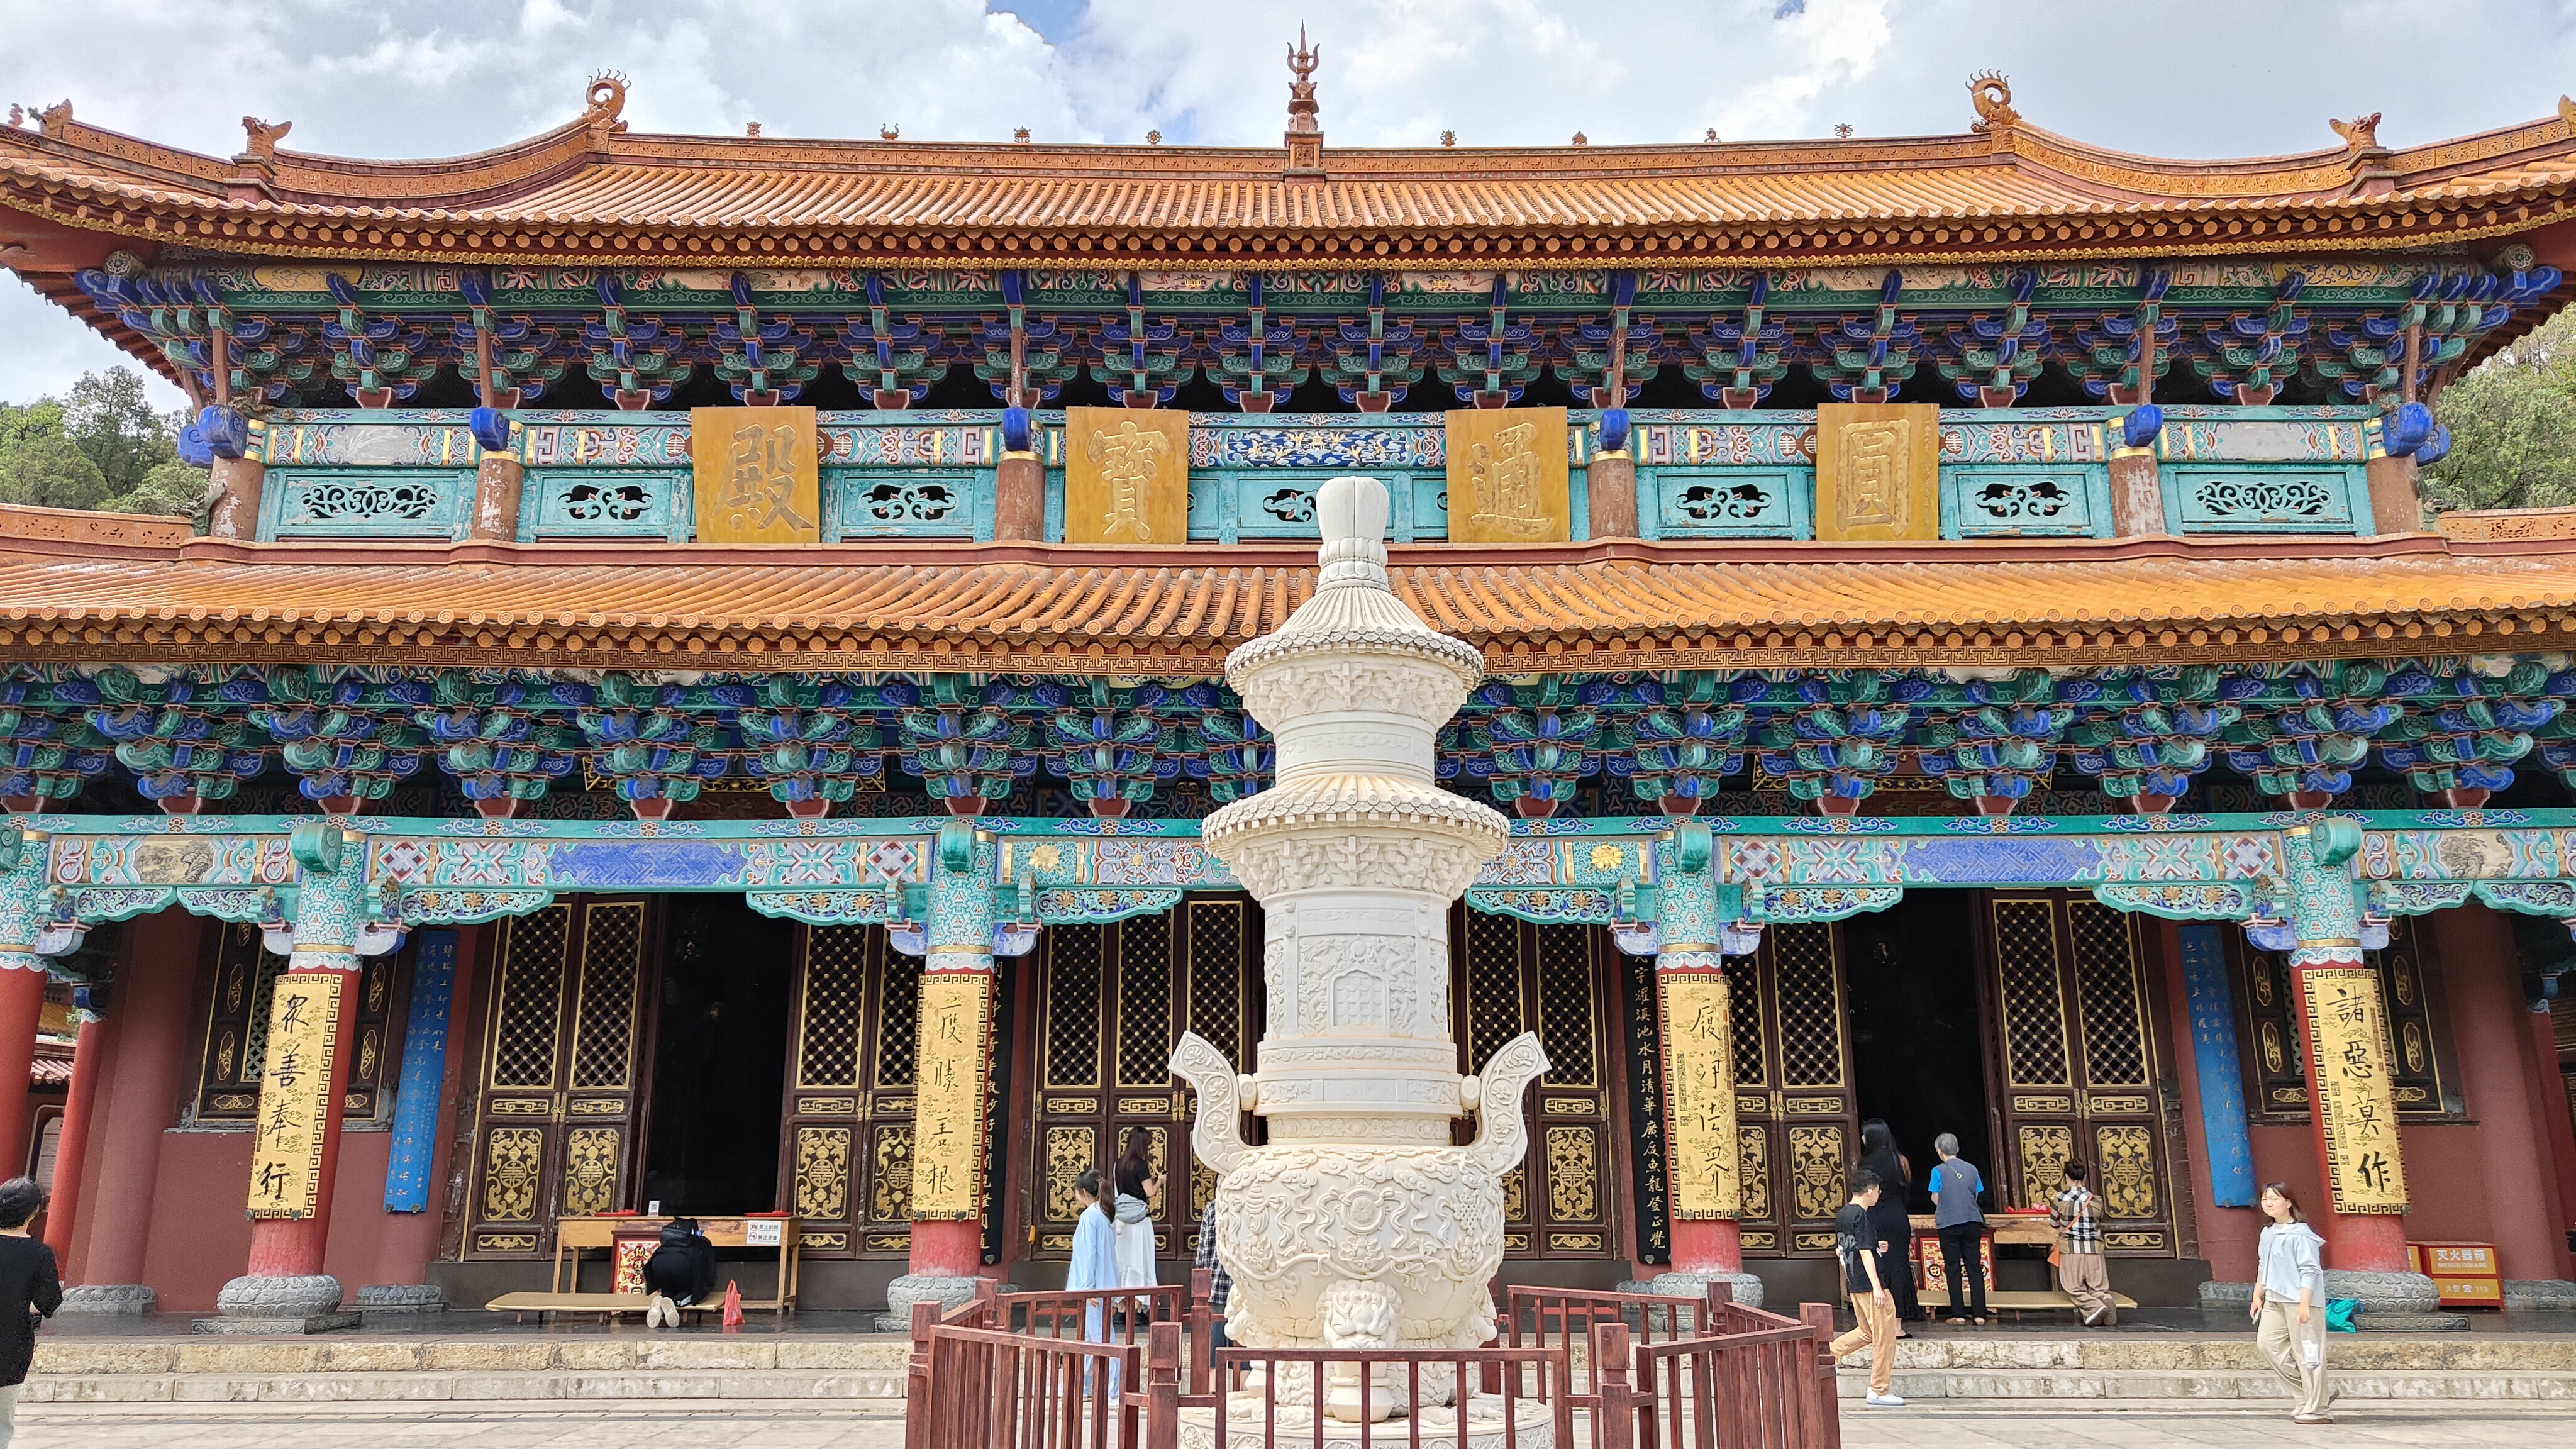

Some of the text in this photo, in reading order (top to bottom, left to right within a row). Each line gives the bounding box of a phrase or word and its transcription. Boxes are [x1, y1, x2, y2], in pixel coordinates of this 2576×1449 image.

[711, 422, 814, 531] 殿
[1469, 421, 1557, 536] 通
[2326, 985, 2390, 1194] 諸惡莫作
[2436, 1248, 2485, 1261] 灭火器箱
